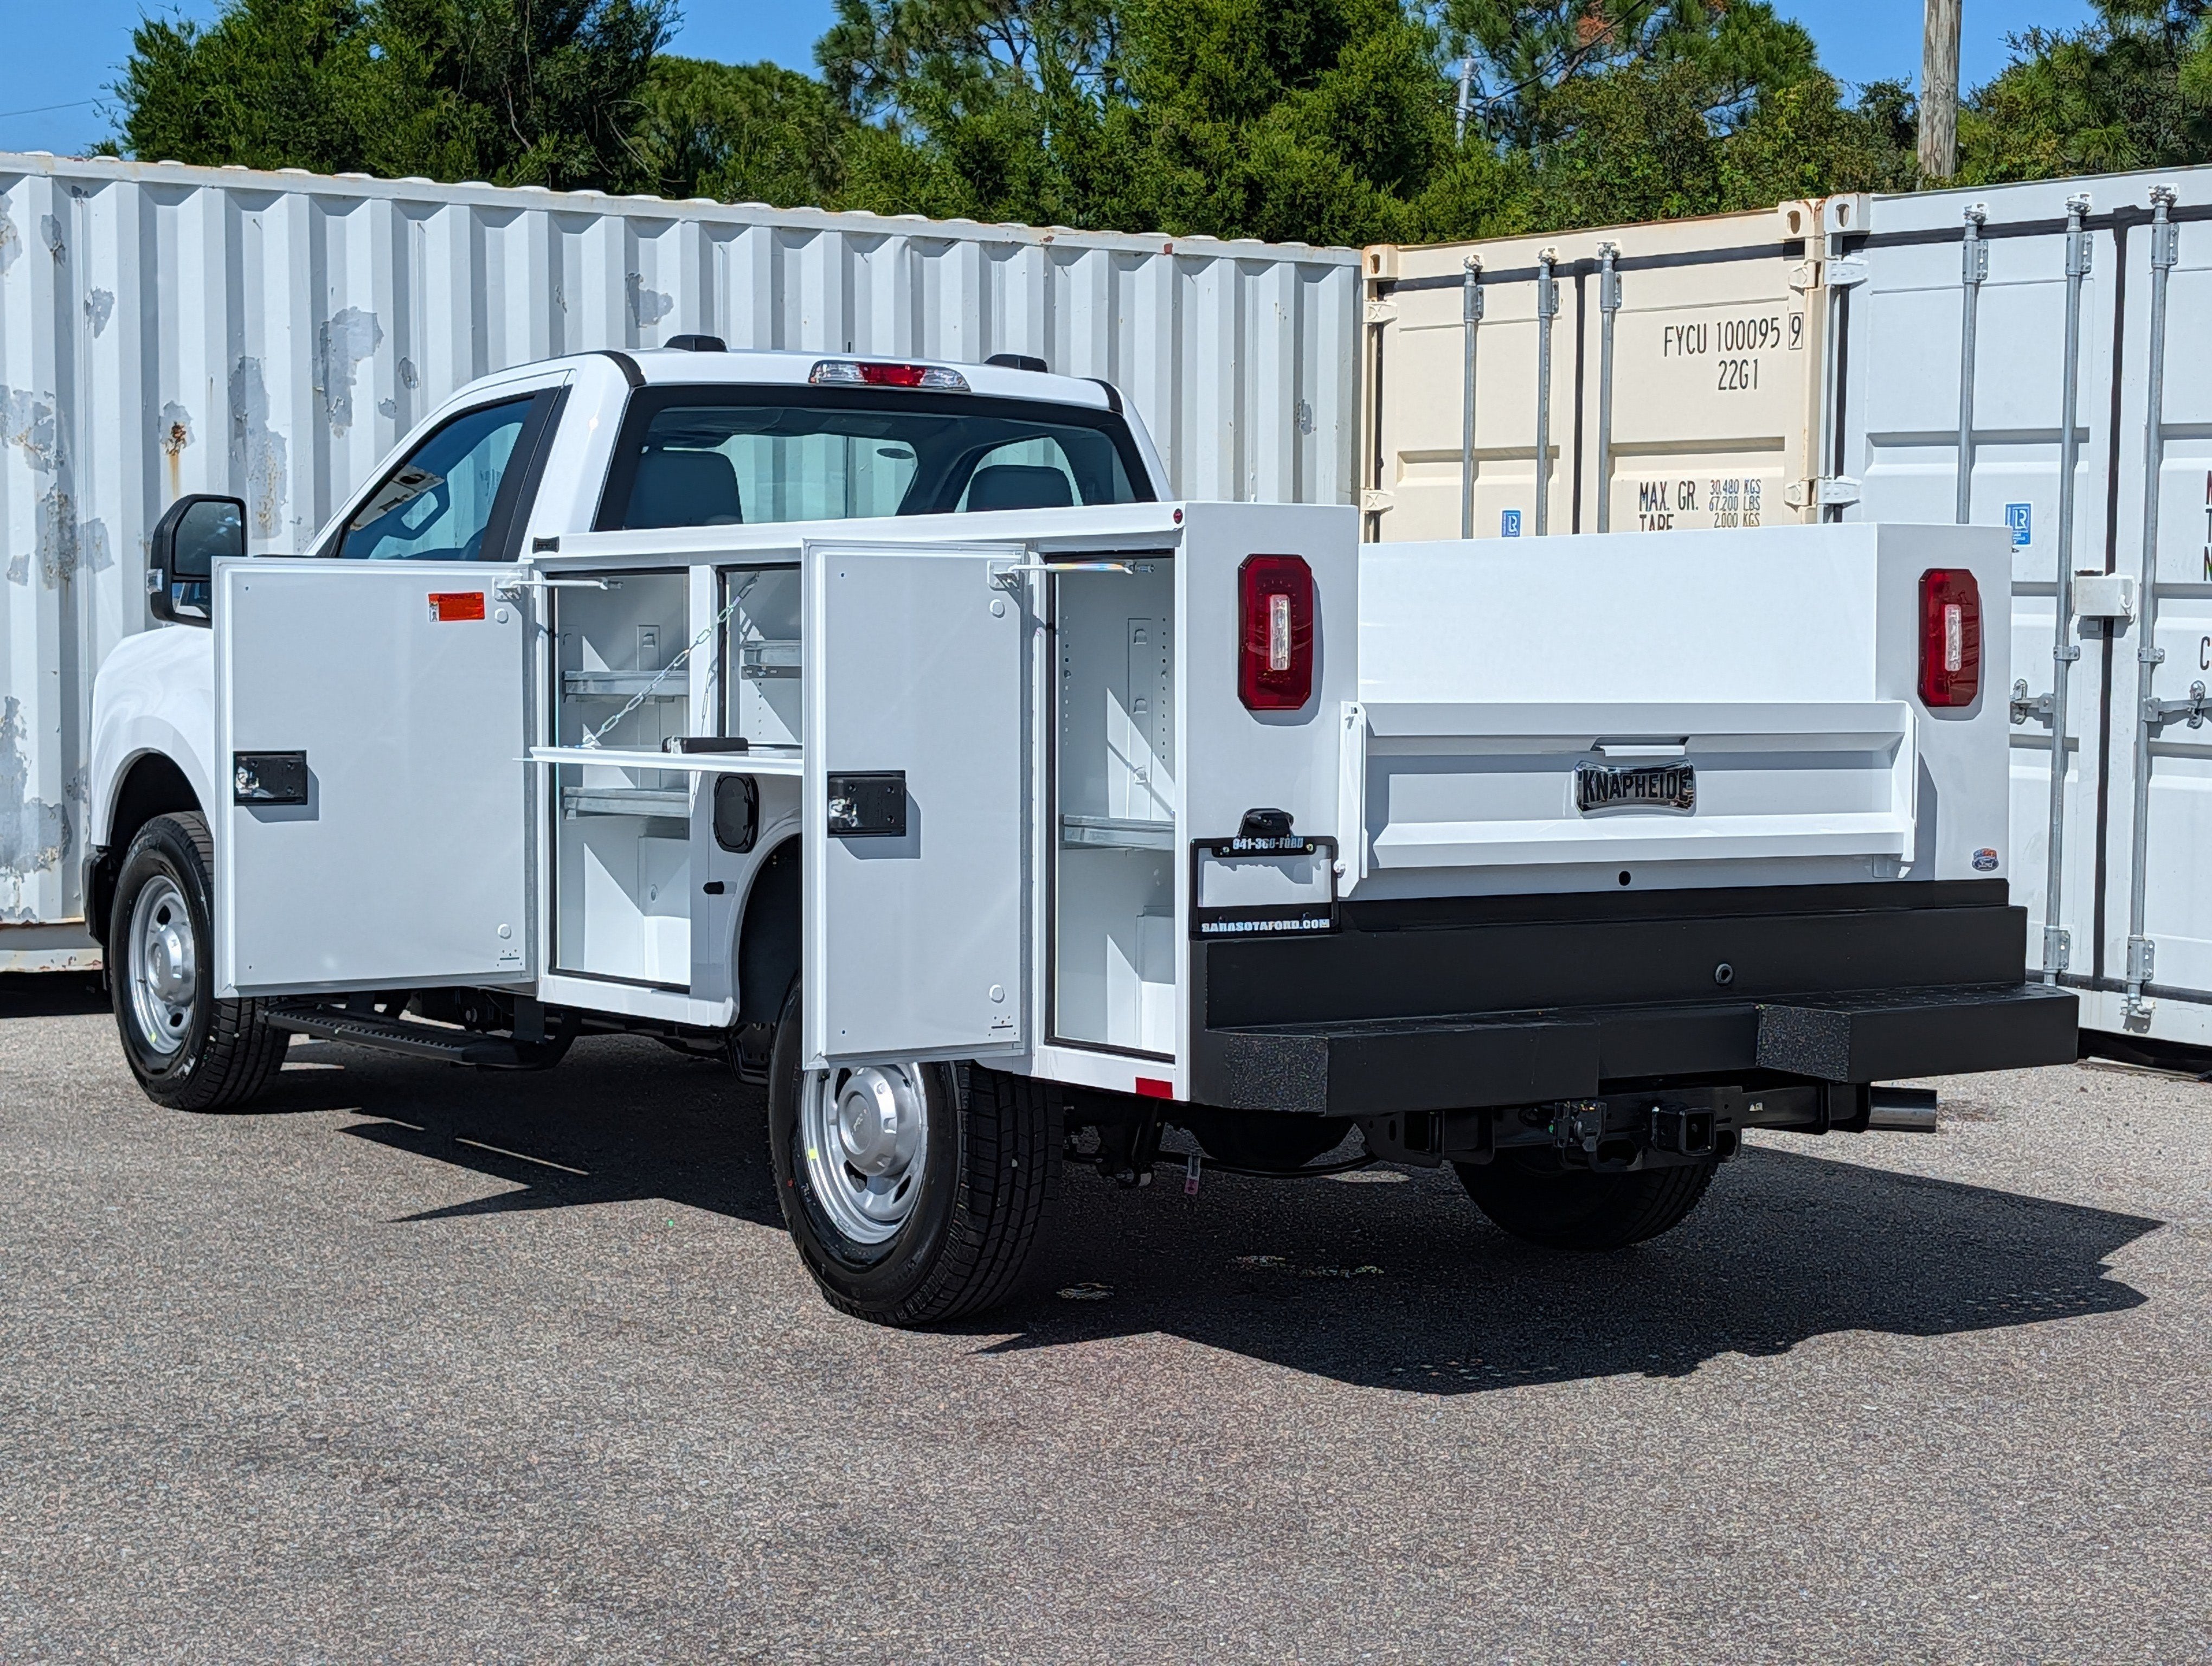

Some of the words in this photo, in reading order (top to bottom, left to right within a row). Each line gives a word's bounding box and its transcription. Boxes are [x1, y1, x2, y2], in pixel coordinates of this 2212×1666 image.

[1664, 323, 1707, 357] FYCU
[1717, 317, 1780, 353] 100095
[1790, 315, 1802, 347] 9
[1718, 358, 1758, 390] 22G1
[1639, 480, 1670, 511] MAX.
[1678, 480, 1699, 510] GR.
[1744, 479, 1761, 495] KGS
[1744, 496, 1760, 511] LBS
[1582, 766, 1689, 803] KNAPHEIDE
[1201, 919, 1329, 932] SARASOTAFORD.COM
